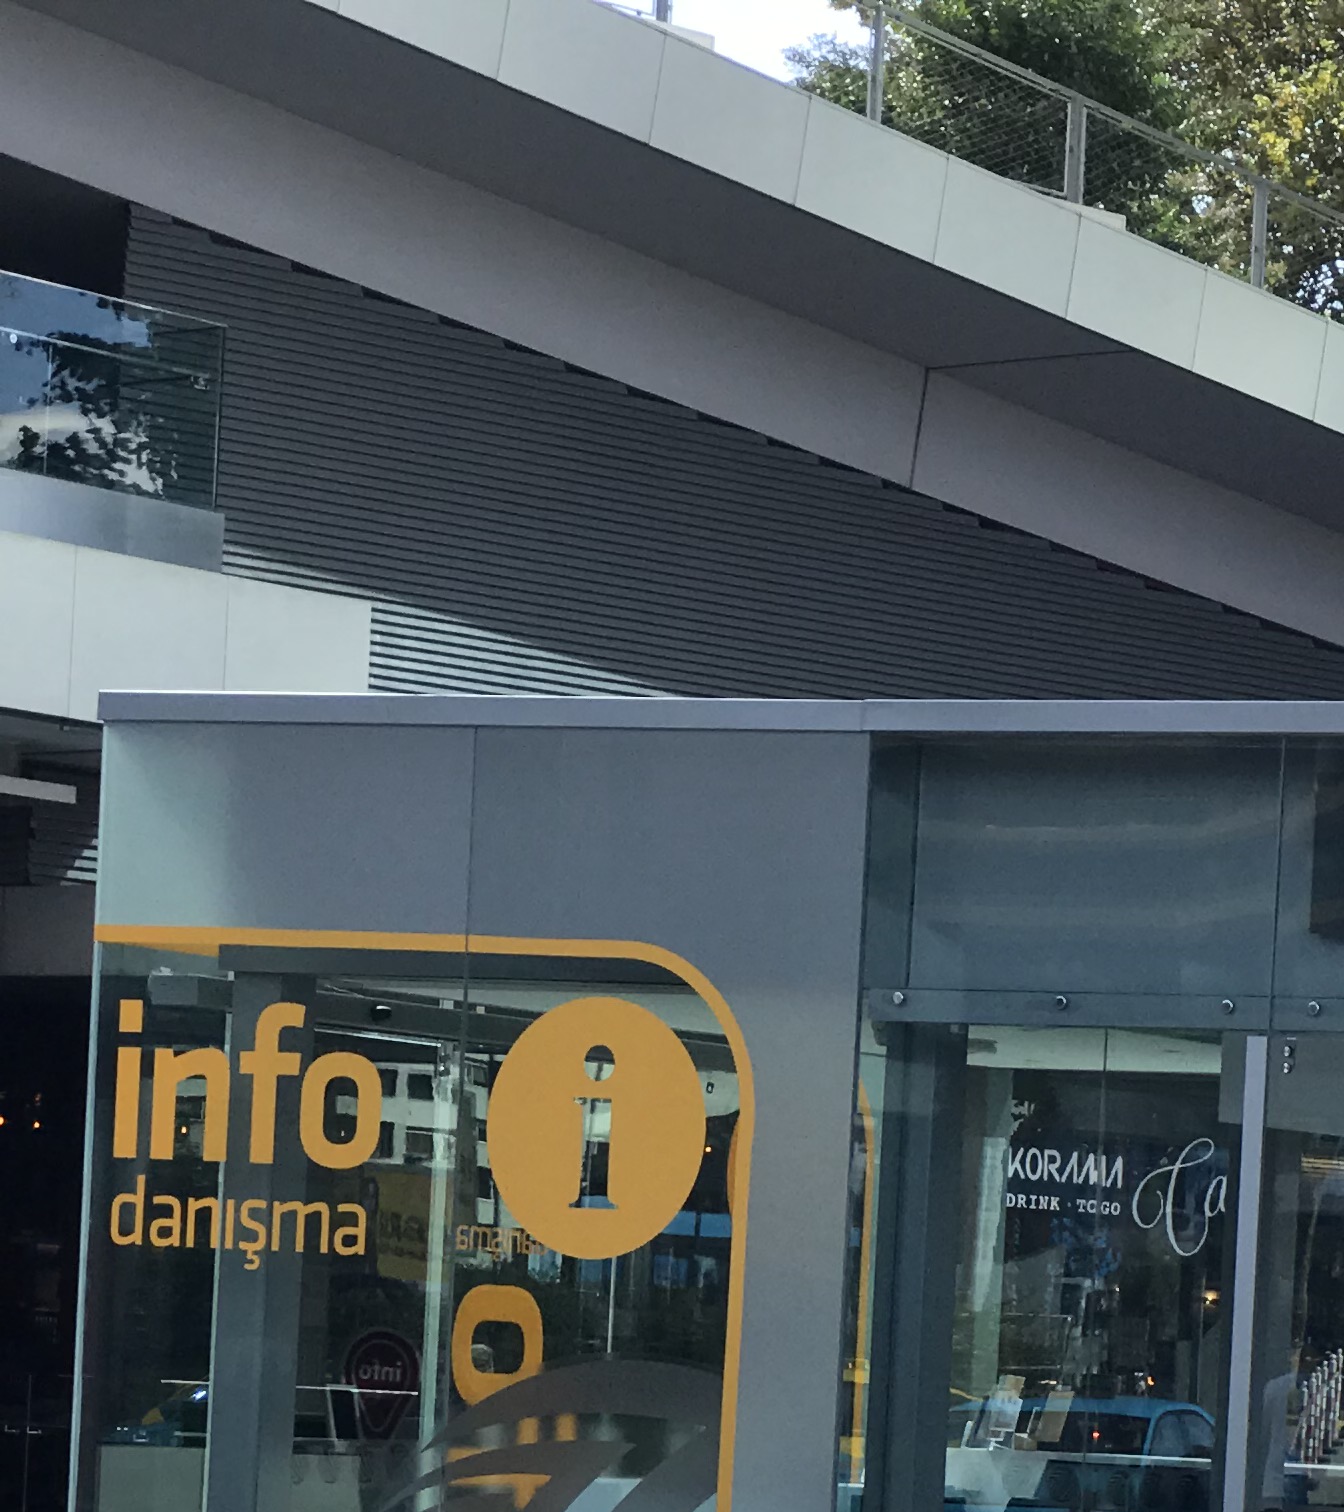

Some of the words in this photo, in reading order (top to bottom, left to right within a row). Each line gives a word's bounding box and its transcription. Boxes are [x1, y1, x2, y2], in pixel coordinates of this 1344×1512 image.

[113, 999, 382, 1169] info
[110, 1174, 367, 1270] danışma
[1006, 1193, 1060, 1211] DRINK
